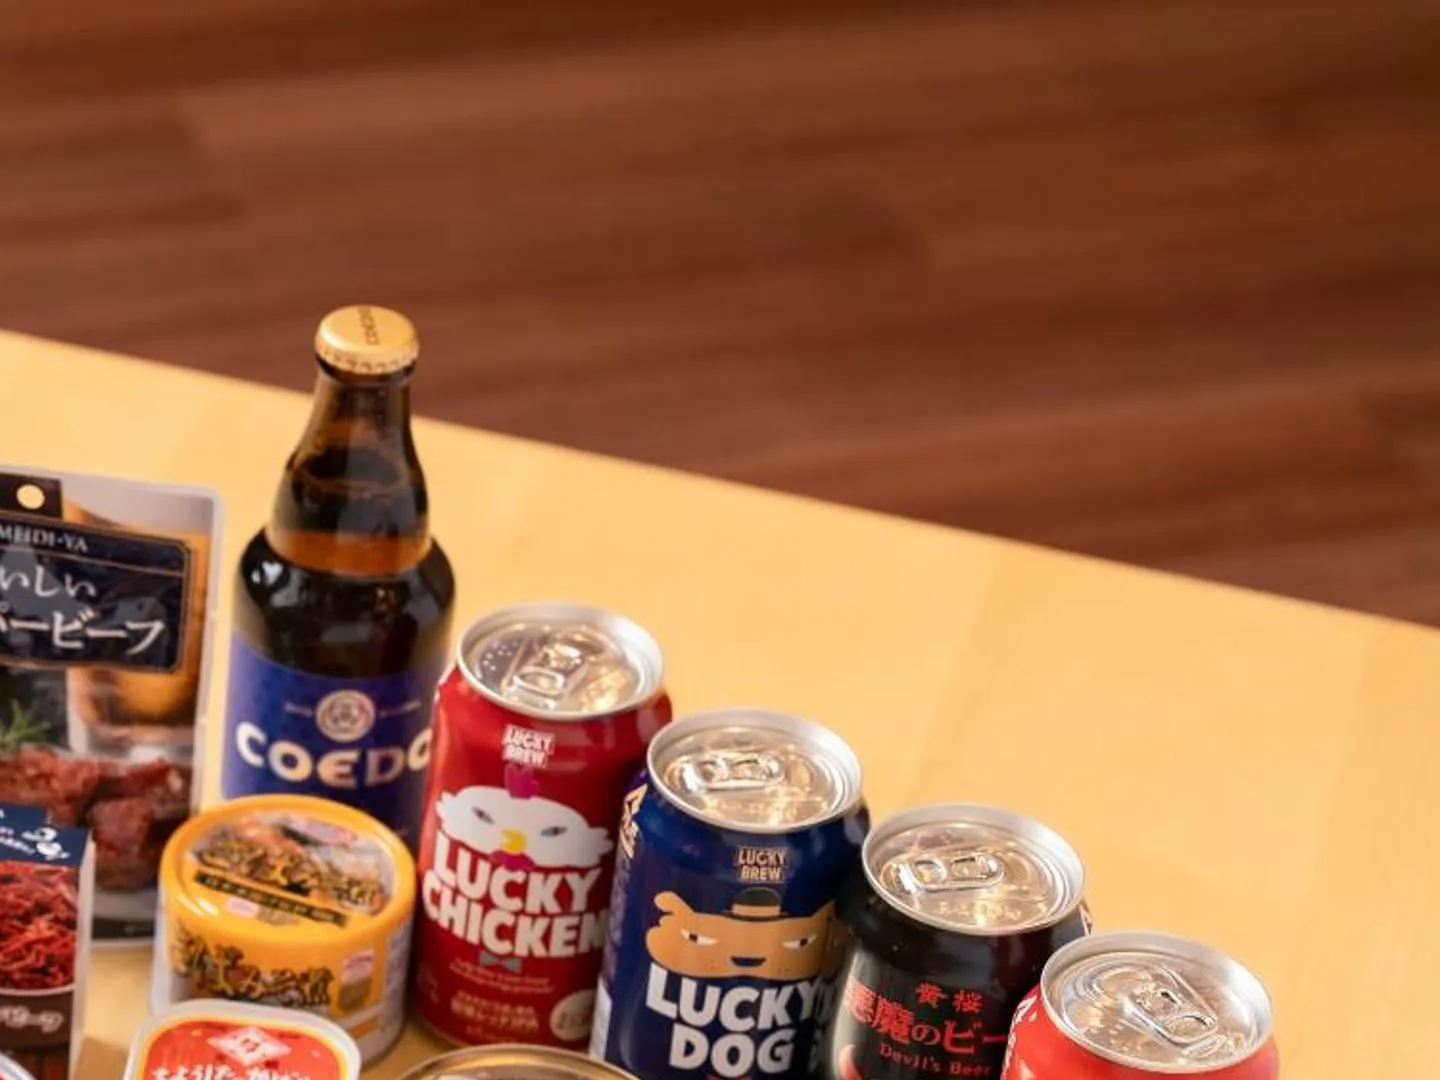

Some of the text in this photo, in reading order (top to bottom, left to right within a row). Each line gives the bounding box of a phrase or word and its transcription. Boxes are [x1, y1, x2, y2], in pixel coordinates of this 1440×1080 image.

[236, 721, 432, 788] COEDO
[503, 745, 546, 767] BREW
[506, 727, 554, 753] LUCKY
[434, 832, 602, 914] LUCKY
[737, 848, 788, 866] LUCKY
[740, 865, 782, 882] BREW
[422, 869, 608, 957] CHICKEN
[646, 963, 818, 1033] LUCKY
[669, 1023, 797, 1079] DOG
[880, 1044, 993, 1077] Devil's Beer
